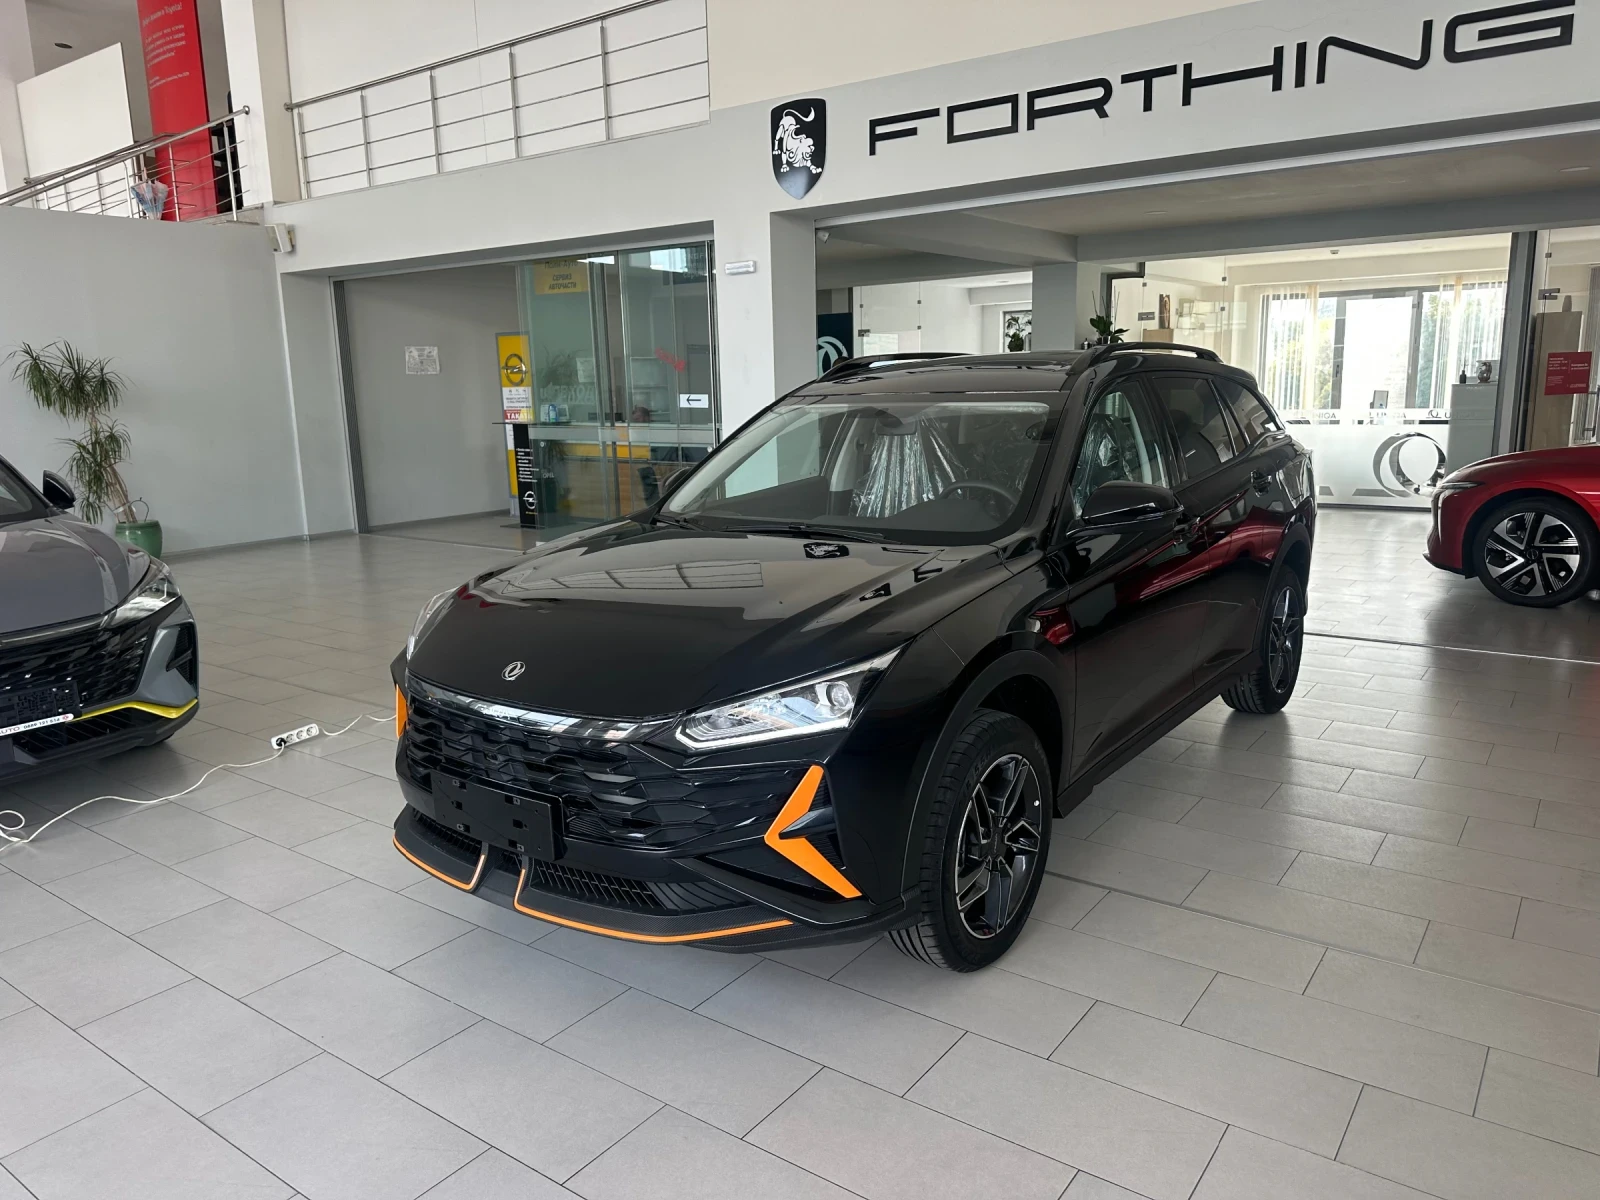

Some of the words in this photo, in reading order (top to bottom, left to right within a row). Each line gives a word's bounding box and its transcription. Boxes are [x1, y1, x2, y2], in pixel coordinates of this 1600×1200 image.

[868, 0, 1577, 155] FORTHING
[552, 272, 572, 282] СЕРВИЗ
[548, 281, 577, 290] АВТОЧАСТИ
